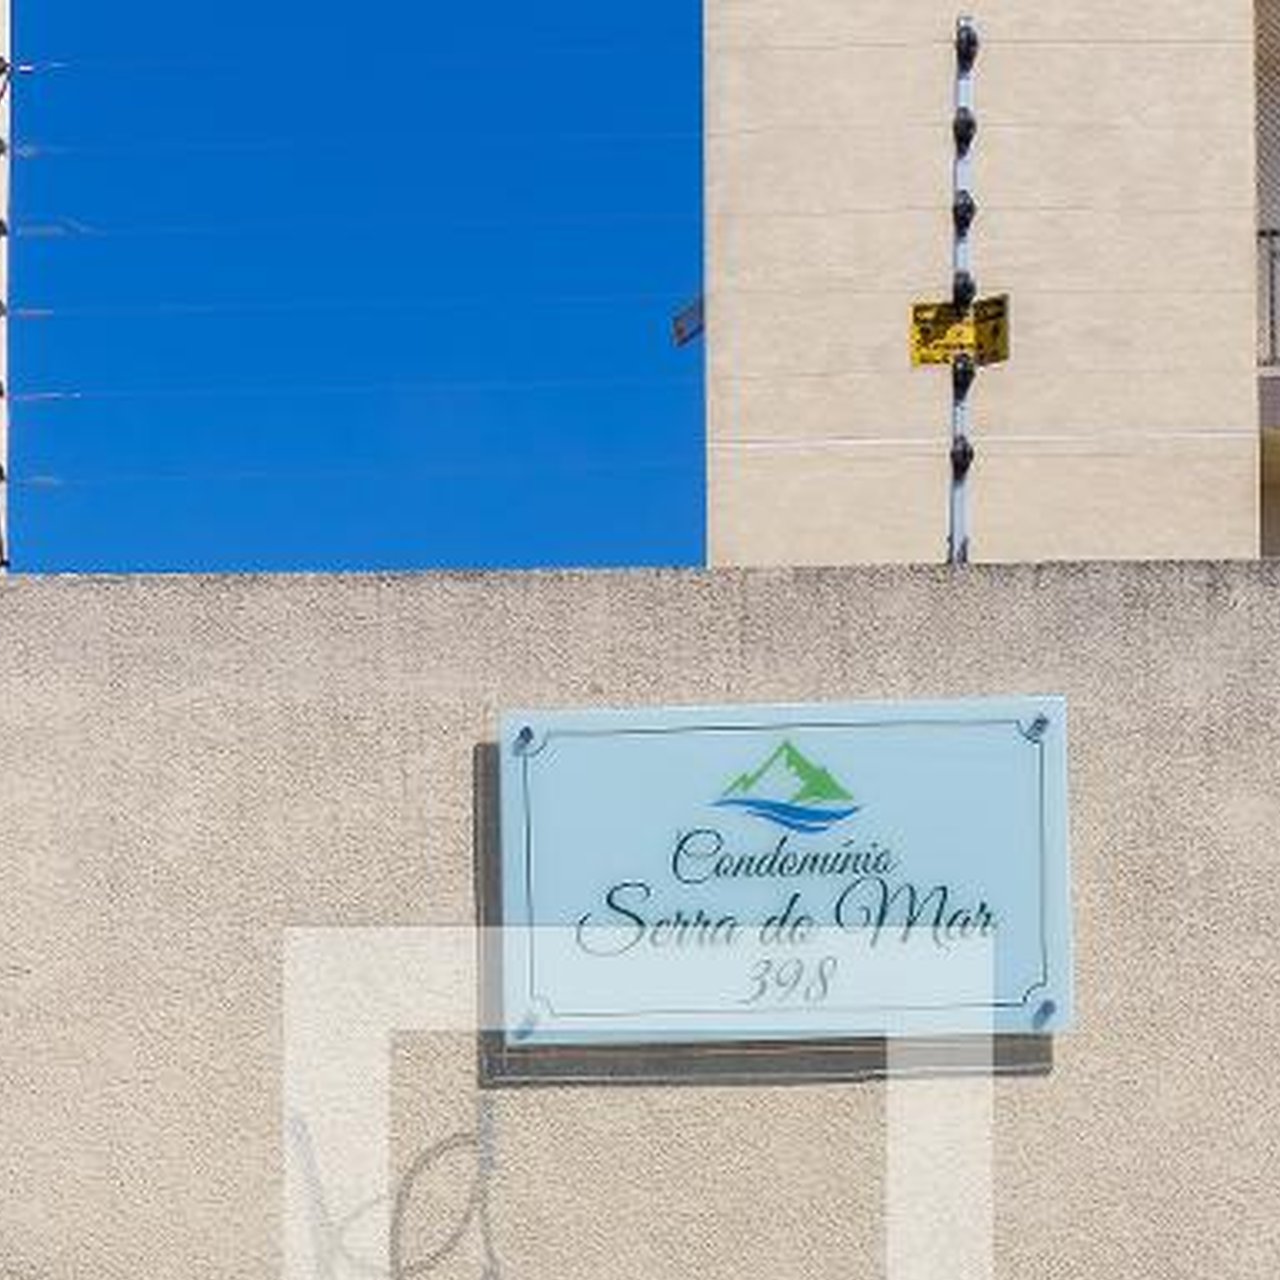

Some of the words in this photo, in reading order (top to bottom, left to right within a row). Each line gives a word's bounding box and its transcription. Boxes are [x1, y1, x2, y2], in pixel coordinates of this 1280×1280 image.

[671, 828, 898, 885] Condomínio
[576, 882, 741, 957] Serra
[834, 876, 998, 954] Mar
[738, 956, 838, 1004] 398
